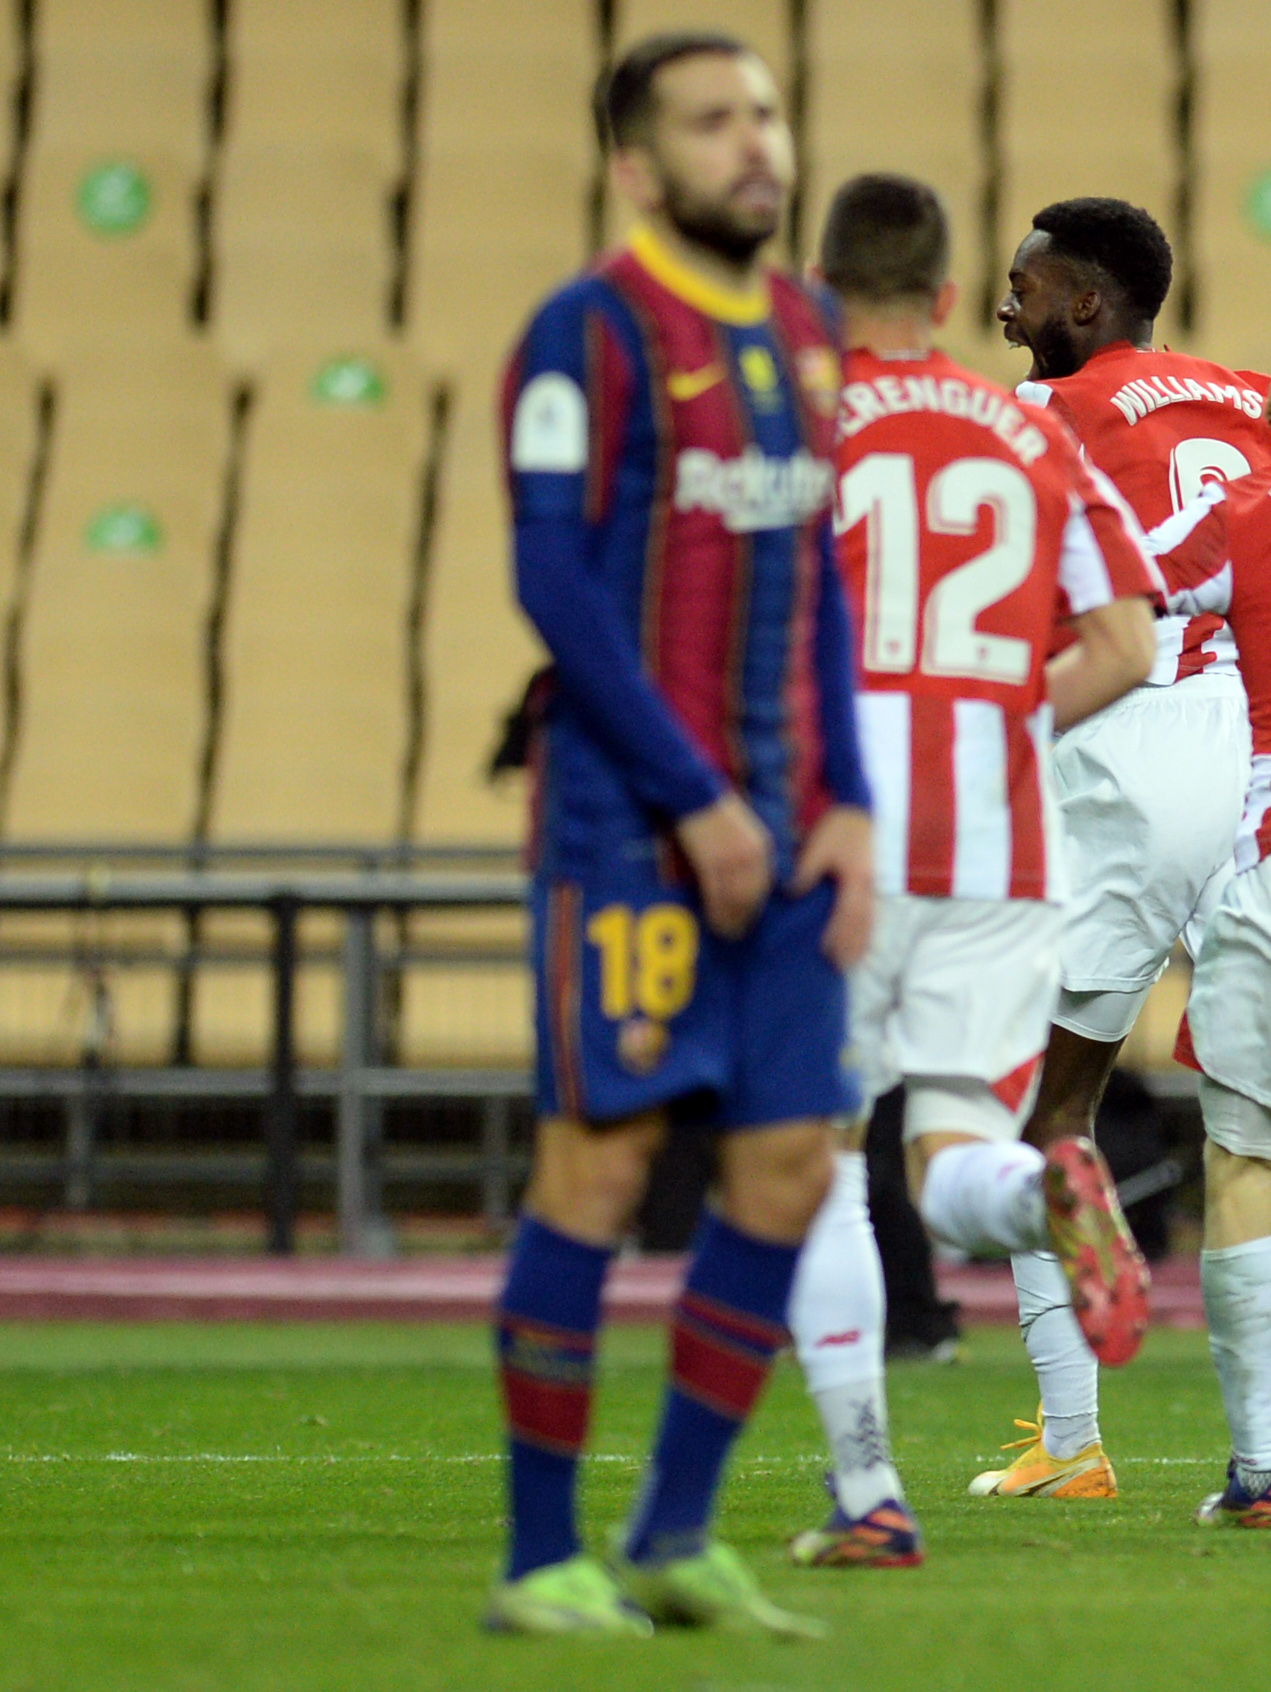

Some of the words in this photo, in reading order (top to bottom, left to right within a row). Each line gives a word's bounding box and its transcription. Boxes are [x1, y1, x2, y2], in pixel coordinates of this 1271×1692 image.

[1110, 376, 1264, 426] WILLIAMS
[834, 452, 1037, 685] 12
[586, 904, 698, 1021] 18
